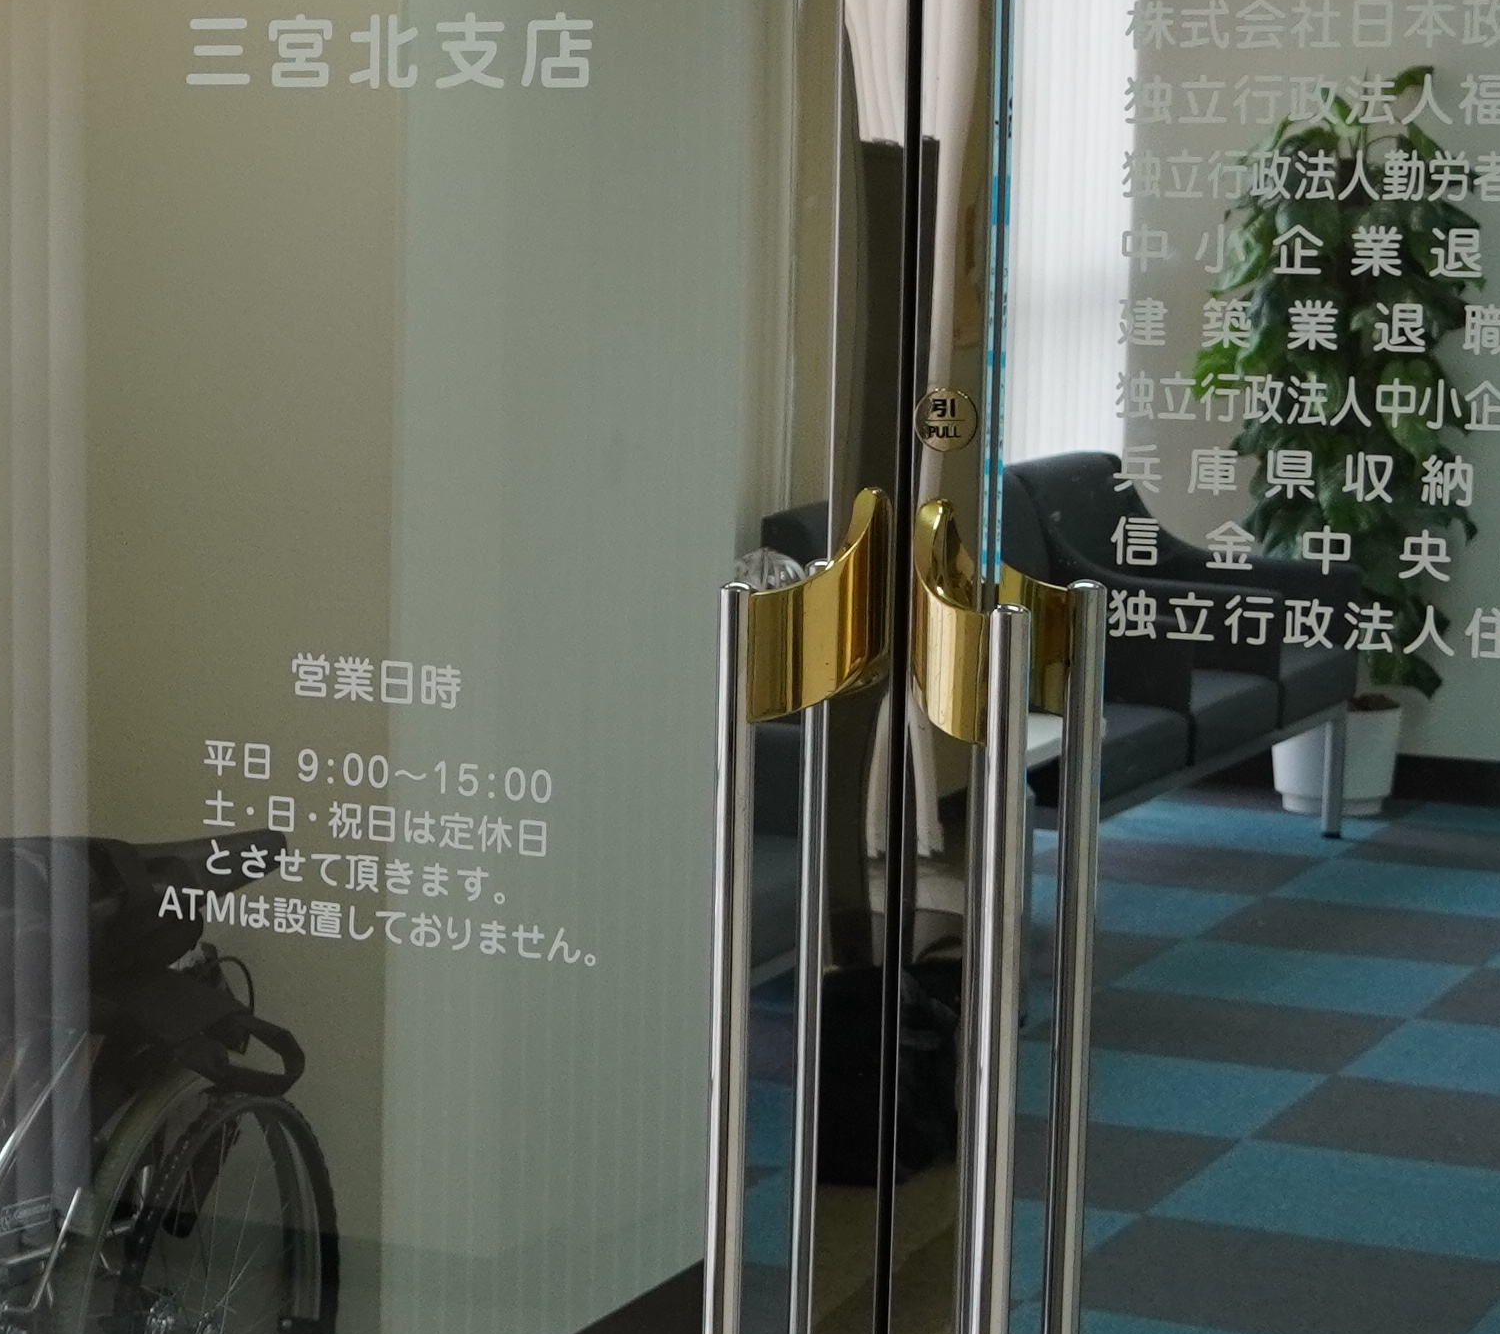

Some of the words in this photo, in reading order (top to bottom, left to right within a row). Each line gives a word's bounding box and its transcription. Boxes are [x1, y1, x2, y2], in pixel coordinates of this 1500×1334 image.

[185, 12, 593, 89] 三宮北支店
[928, 426, 961, 439] PULL
[931, 398, 956, 418] 引
[290, 652, 462, 709] 営業日時
[203, 739, 271, 780] 平日
[203, 790, 548, 857] 土・日・祝日は定休日
[205, 840, 506, 905] とさせて頂きます。
[158, 886, 597, 966] ATMは設置しておりません。
